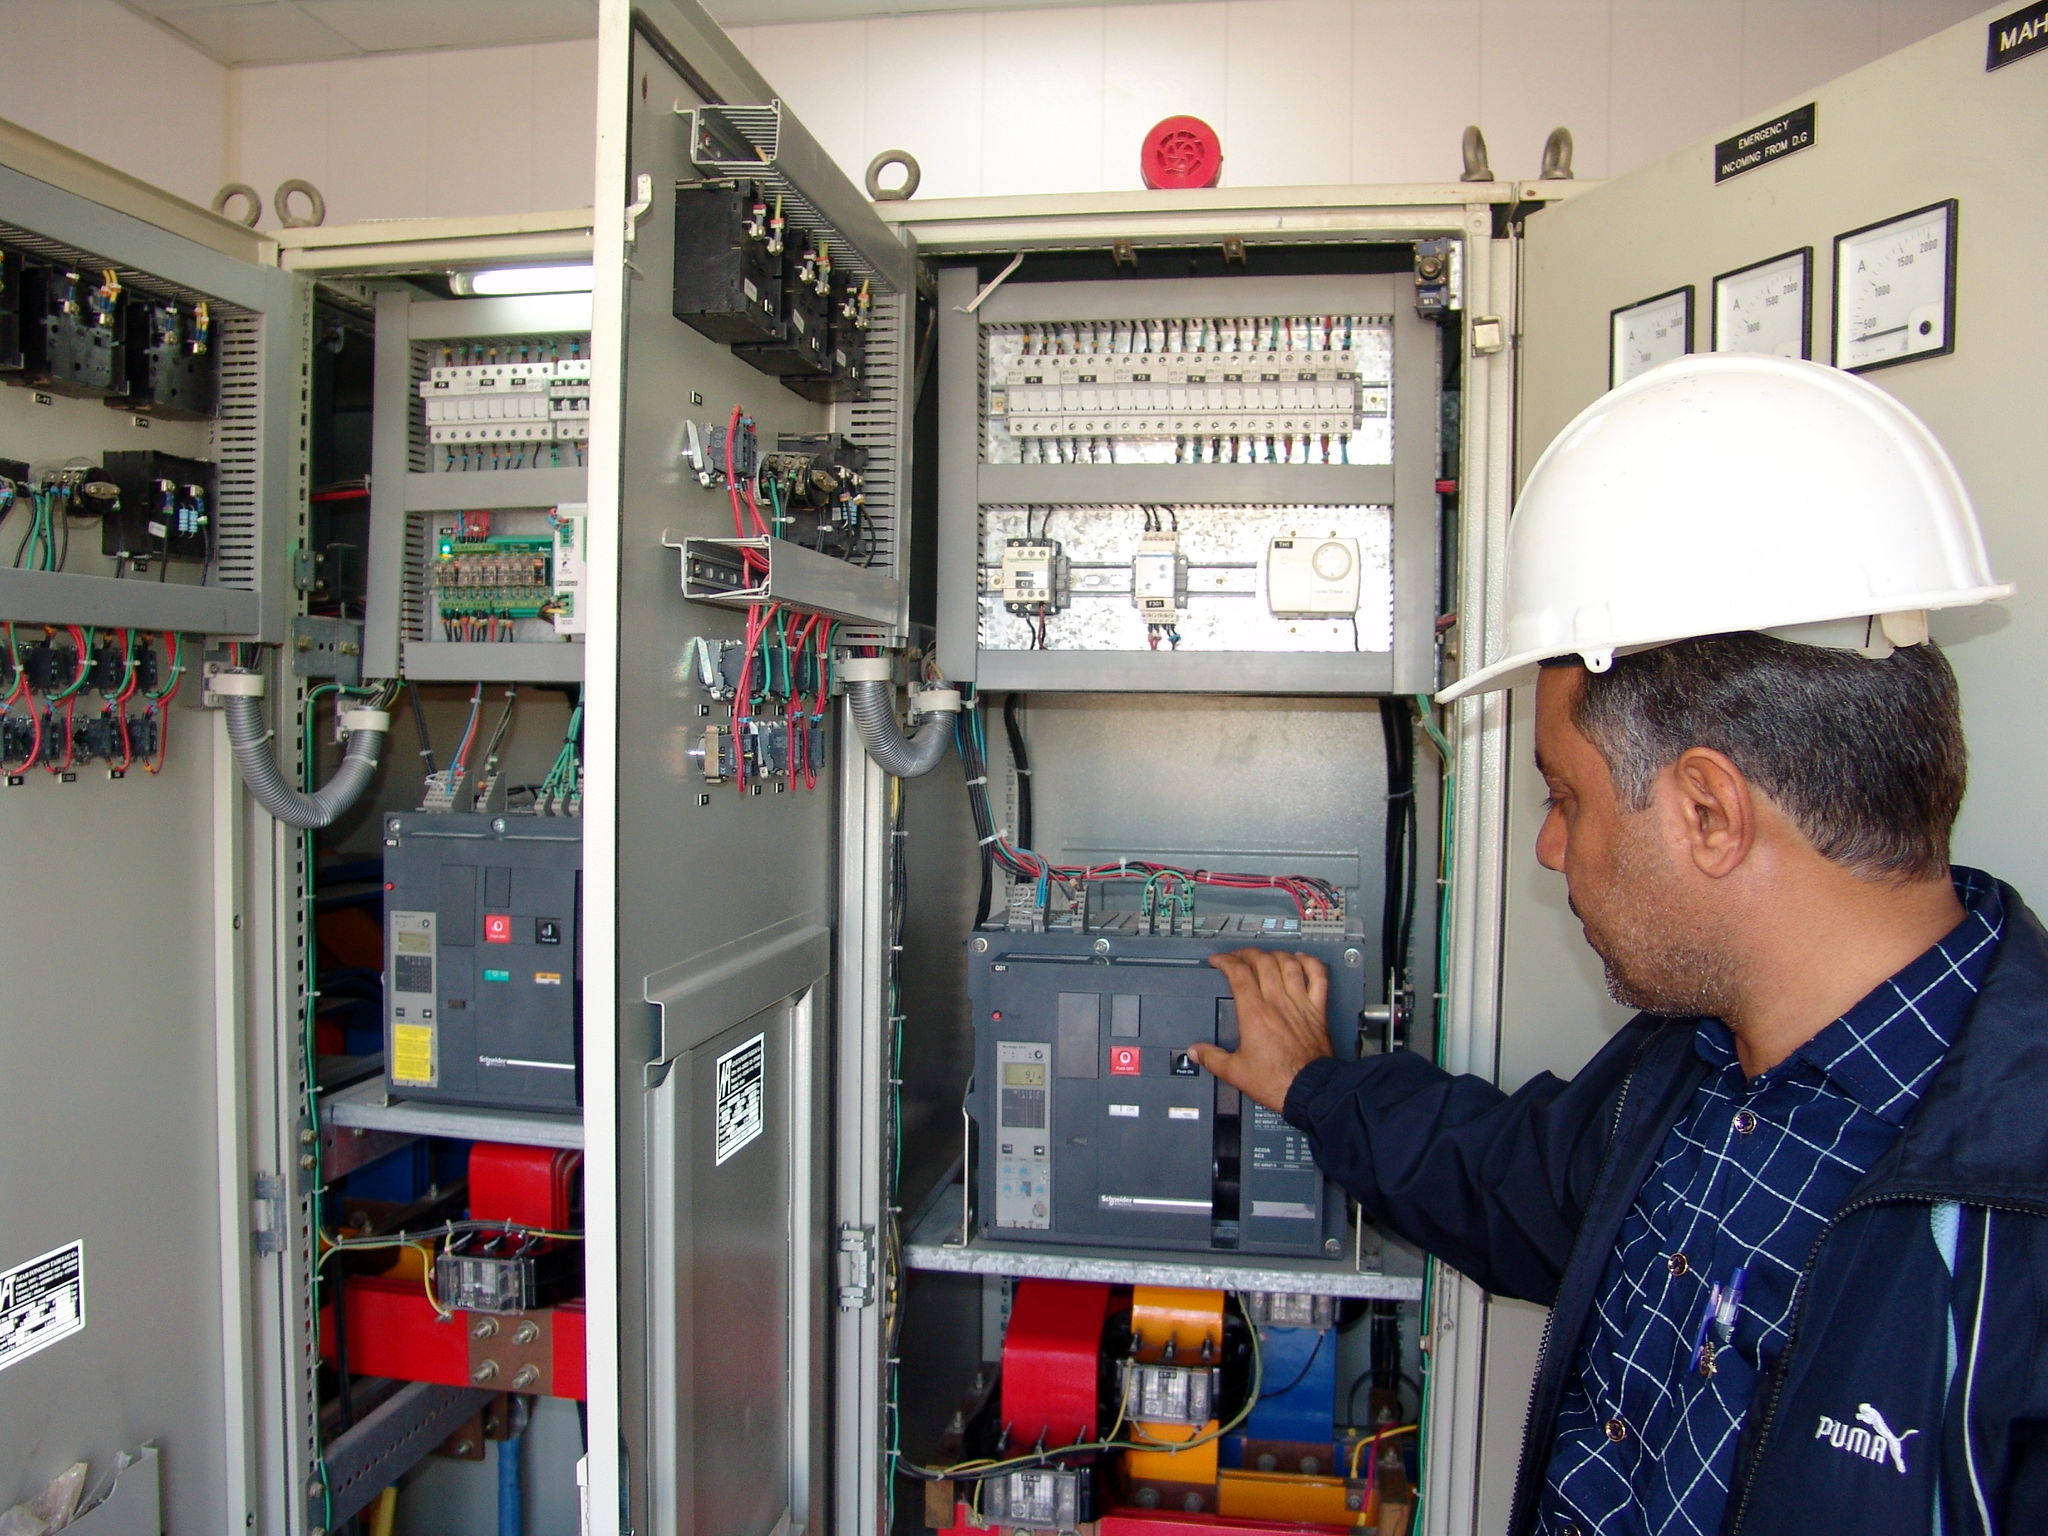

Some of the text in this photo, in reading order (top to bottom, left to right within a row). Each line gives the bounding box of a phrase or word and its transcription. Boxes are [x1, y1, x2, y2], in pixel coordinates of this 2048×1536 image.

[2000, 12, 2048, 51] MAH
[1738, 119, 1789, 150] EMERGENCY
[1721, 131, 1808, 175] INCOMING FROM D.G
[1919, 238, 1938, 254] 2000
[1857, 259, 1866, 273] A
[1897, 253, 1914, 268] 1500
[1874, 284, 1891, 297] 1000
[1733, 299, 1741, 311] A
[1863, 316, 1877, 329] 500
[1101, 1194, 1132, 1202] Schneider
[1814, 1415, 1889, 1464] PUMA
